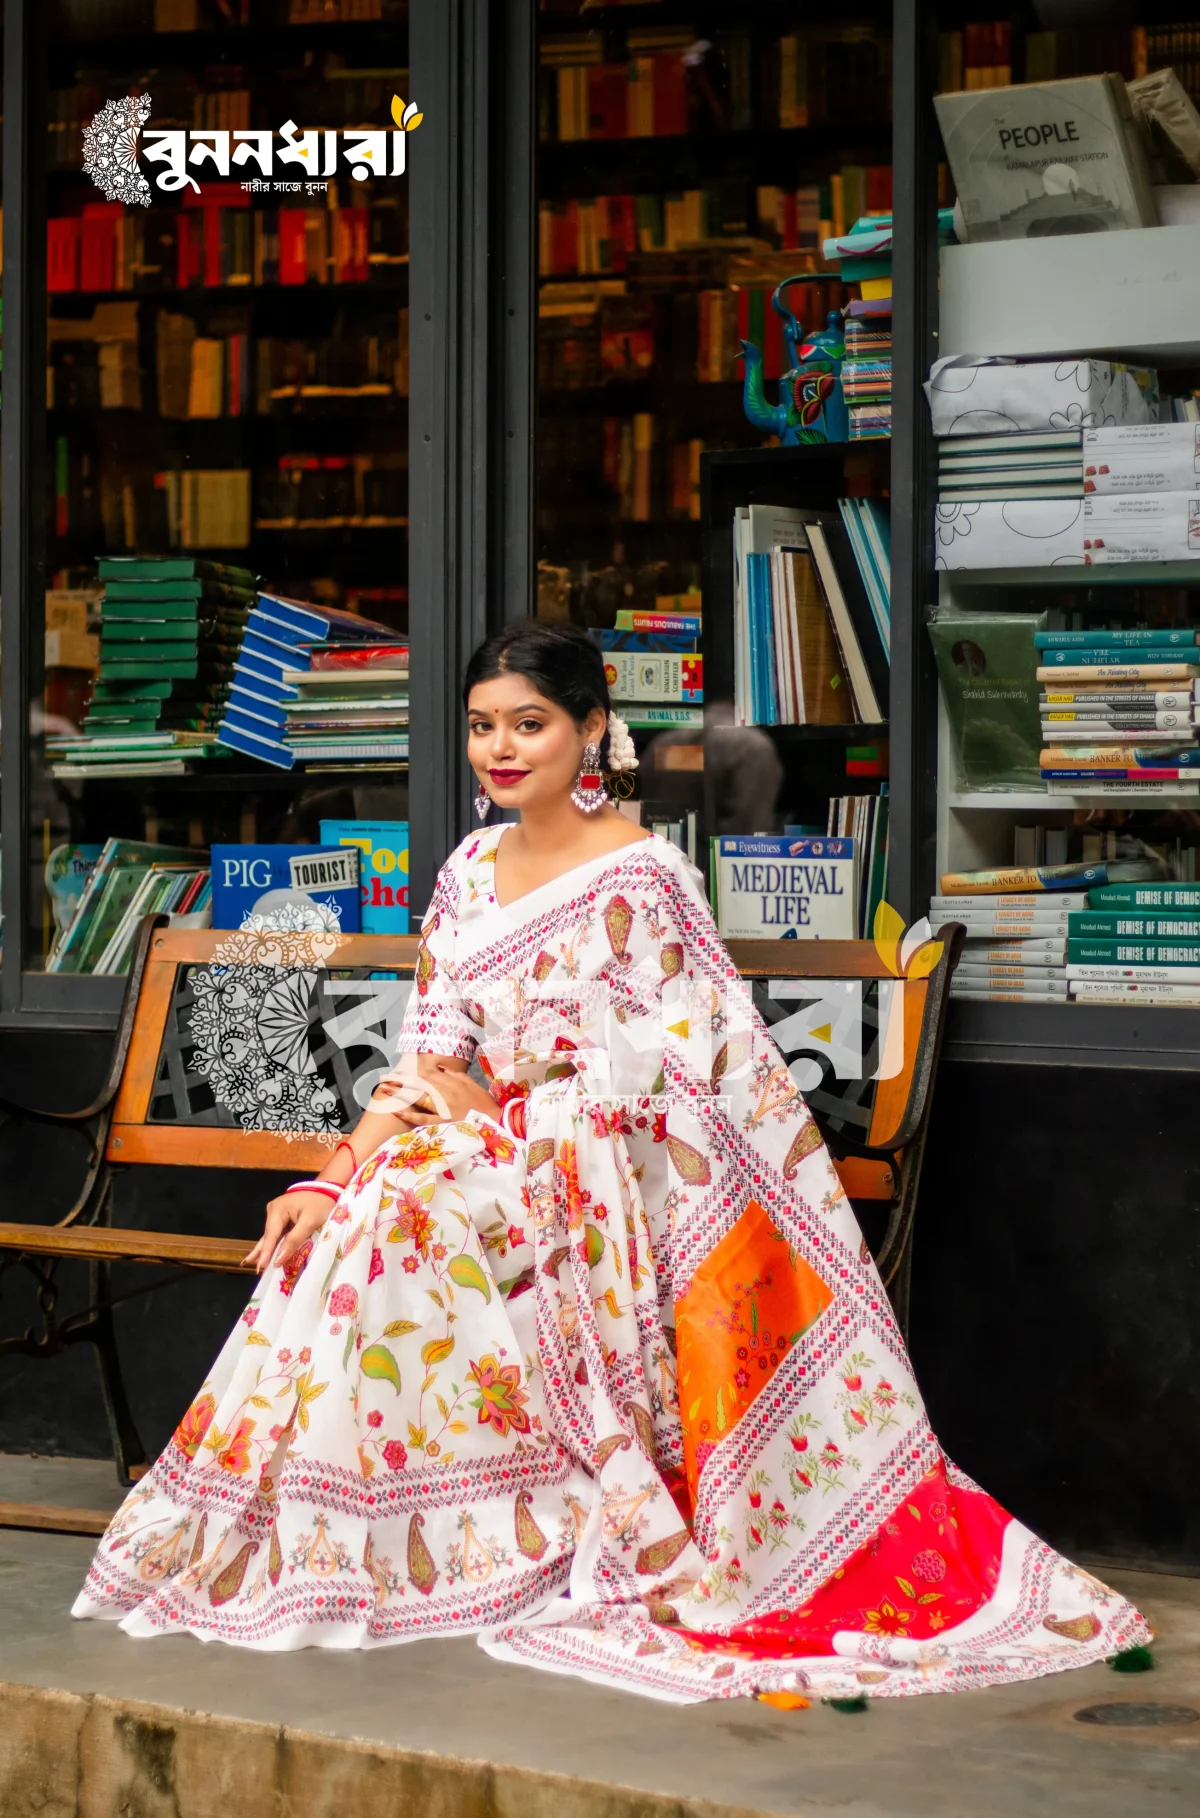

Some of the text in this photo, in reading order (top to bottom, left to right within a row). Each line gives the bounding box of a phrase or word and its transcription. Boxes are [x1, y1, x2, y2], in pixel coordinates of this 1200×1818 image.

[998, 120, 1080, 150] PEOPLE
[1080, 152, 1109, 162] STATION
[634, 619, 697, 630] THE FABULOUS FRUITS
[647, 711, 674, 720] ANIMAL
[1090, 754, 1121, 763] BANKER
[1122, 754, 1133, 762] TO
[739, 841, 781, 856] Eyewitness
[222, 859, 272, 887] PIG
[294, 859, 347, 887] TOURIST
[731, 864, 844, 895] MEDIEVAL
[992, 876, 1024, 887] BANKER
[1025, 875, 1037, 884] TO
[1136, 891, 1162, 905] DEMISE
[1164, 891, 1173, 905] OF
[761, 896, 811, 925] LIFE
[1117, 920, 1144, 935] DEMISE
[1146, 921, 1155, 935] OF
[1117, 946, 1144, 961] DEMISE
[1146, 947, 1155, 961] OF
